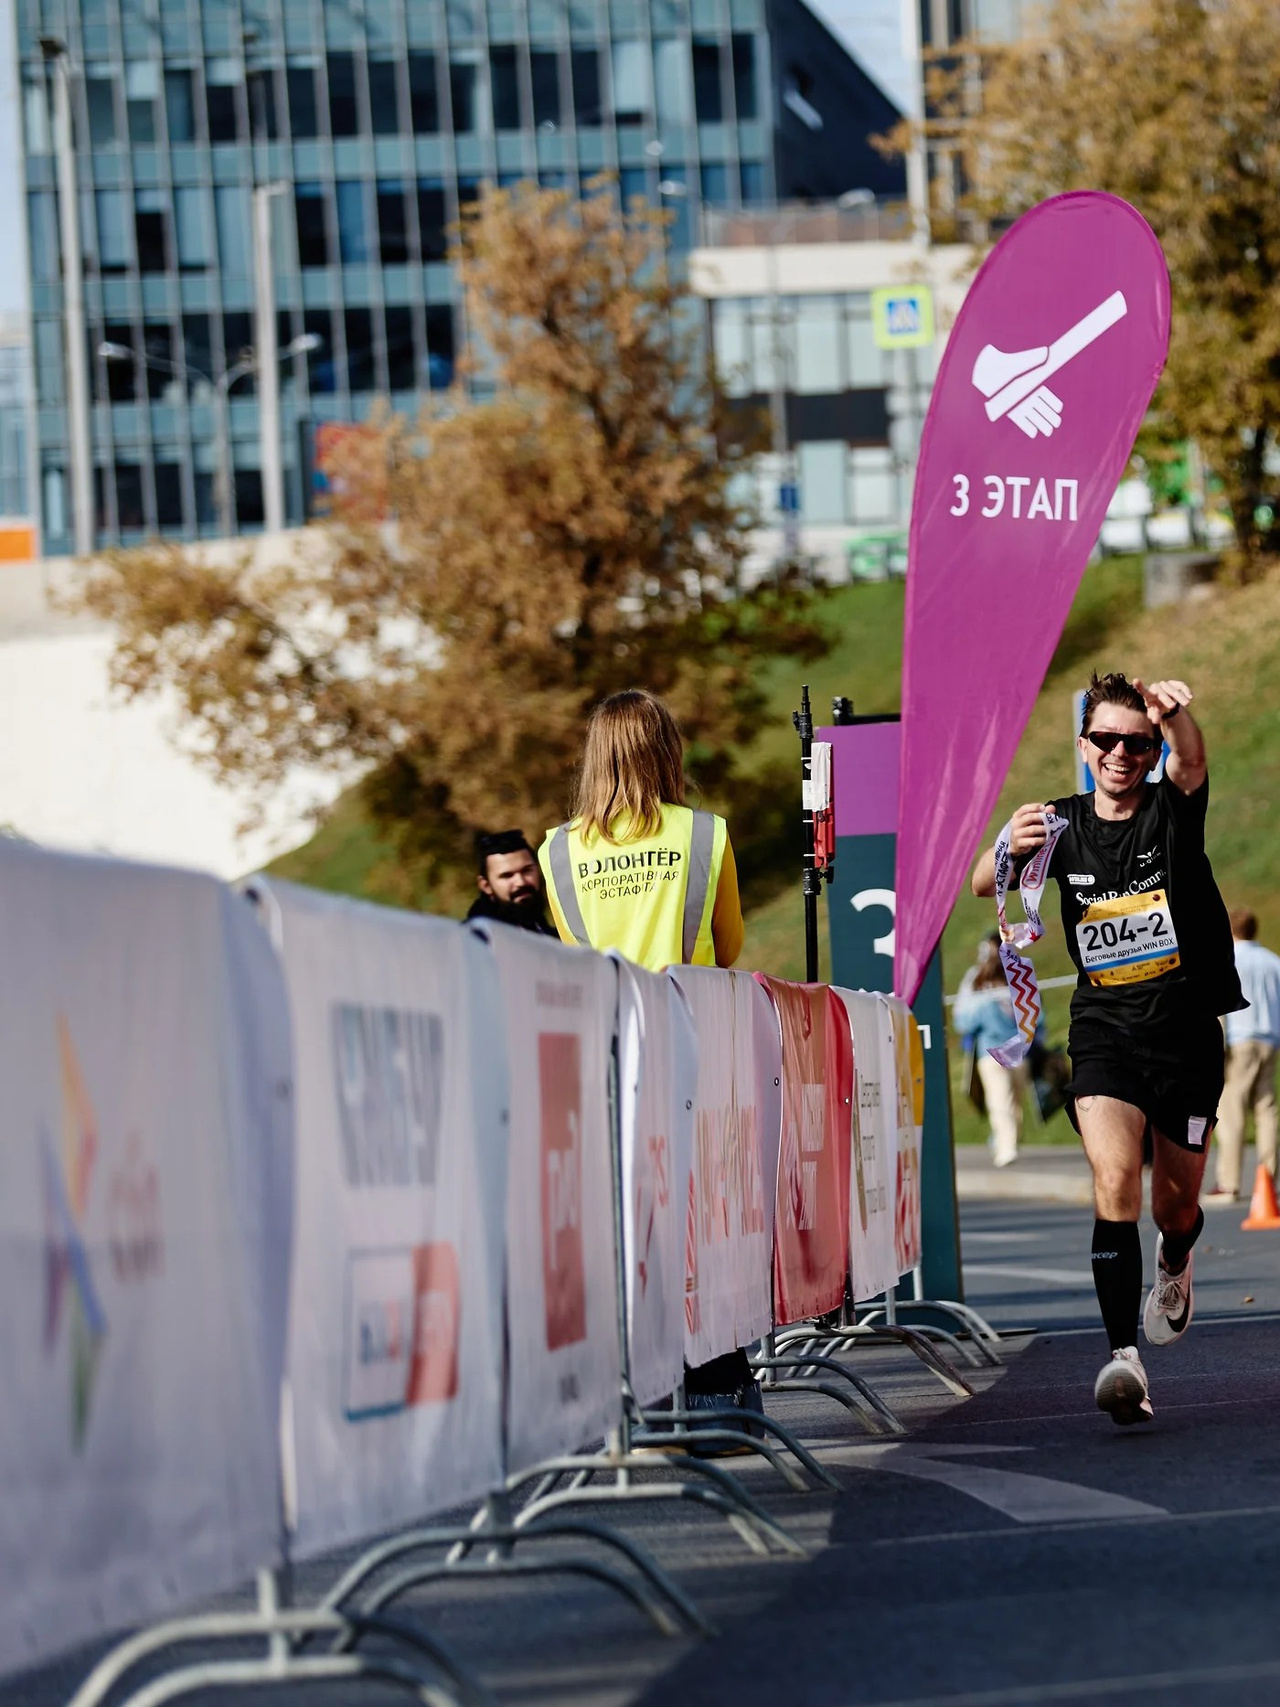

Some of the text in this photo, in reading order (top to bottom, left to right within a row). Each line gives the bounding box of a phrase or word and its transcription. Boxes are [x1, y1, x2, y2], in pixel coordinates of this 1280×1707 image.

[950, 473, 1078, 521] 3 ЭТАП
[578, 848, 681, 879] ВОЛОНТЁР
[600, 882, 656, 900] ЭСТАФТ
[1076, 891, 1106, 906] Social
[1083, 912, 1168, 951] 204-2
[1085, 937, 1174, 964] Беговые друзья WIN BOX
